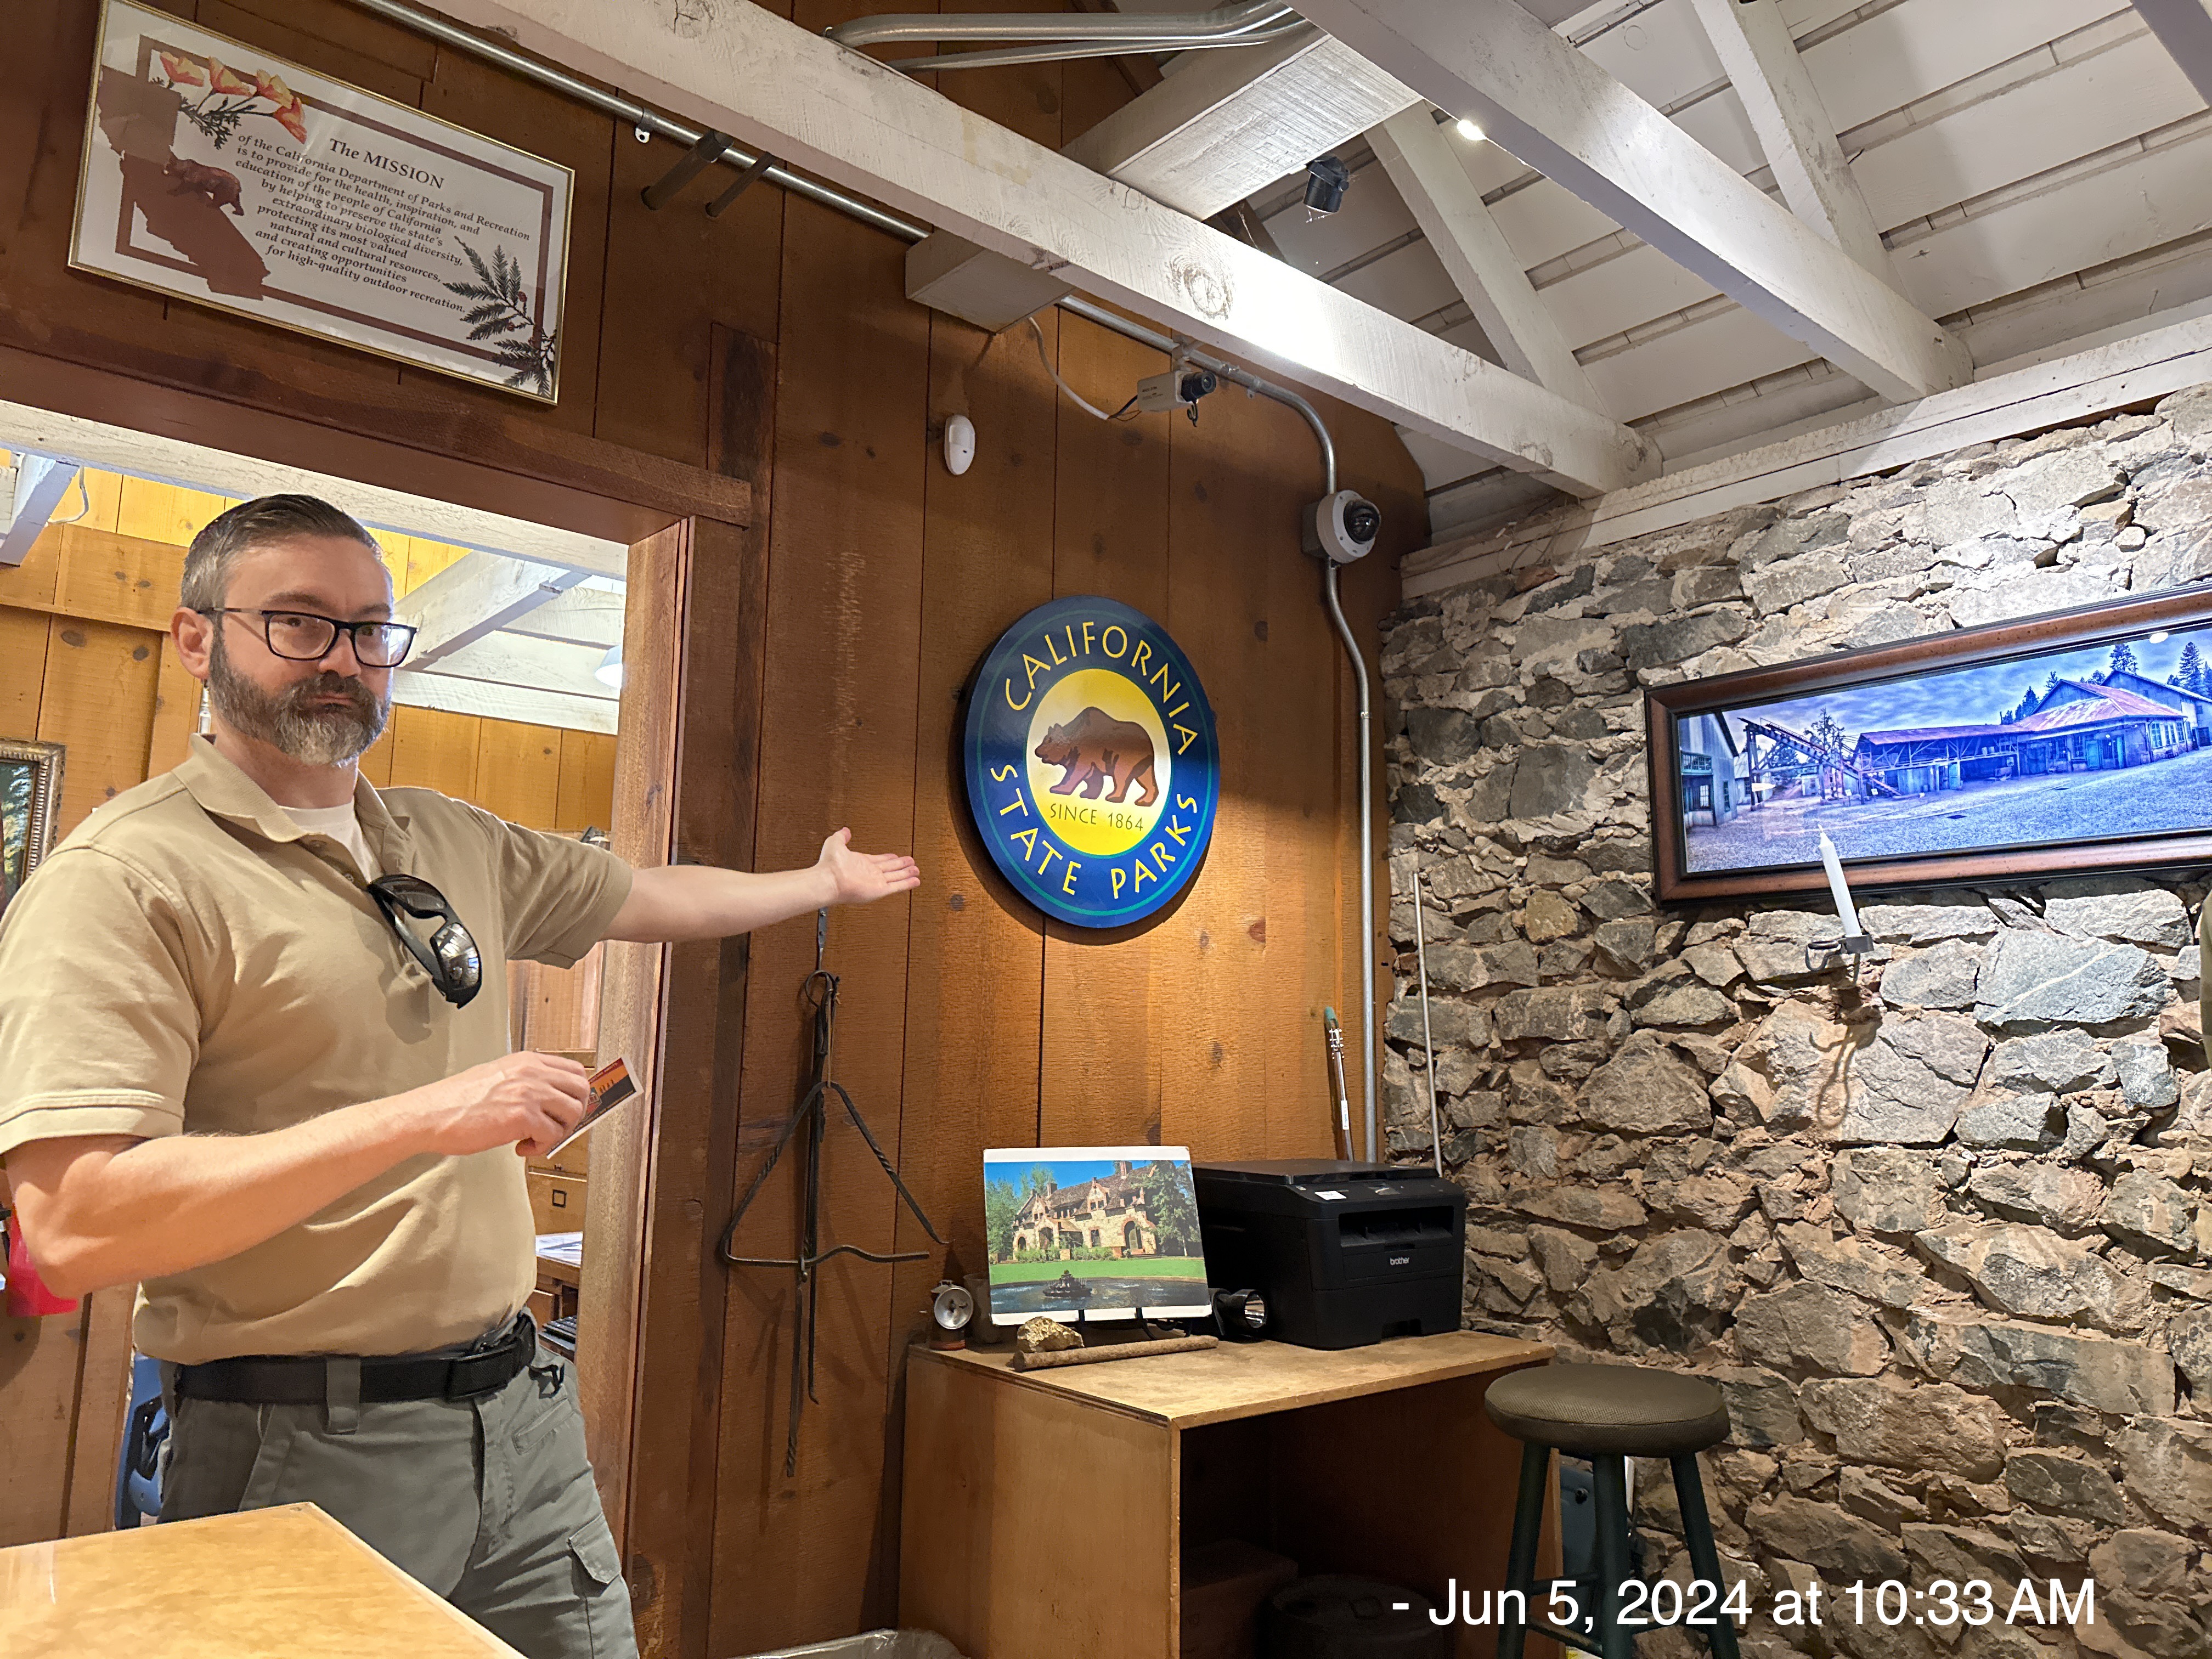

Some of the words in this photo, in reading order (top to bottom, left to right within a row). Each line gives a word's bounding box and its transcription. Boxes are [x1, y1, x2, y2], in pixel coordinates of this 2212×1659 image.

[235, 160, 294, 184] education
[298, 180, 311, 191] of
[313, 184, 331, 196] the
[332, 192, 370, 210] people
[373, 205, 386, 216] of
[387, 209, 442, 234] California
[237, 145, 247, 155] is
[251, 150, 263, 161] to
[266, 157, 312, 177] provide
[312, 172, 331, 183] for
[334, 179, 352, 191] the
[354, 185, 392, 206] health,
[396, 200, 457, 228] inspiration,
[460, 224, 480, 235] and
[238, 134, 252, 146] of
[254, 138, 273, 151] the
[276, 146, 335, 173] California
[338, 167, 405, 198] Department
[408, 194, 420, 204] of
[421, 196, 451, 213] Parks
[454, 210, 474, 221] and
[476, 215, 530, 240] Recreation
[330, 138, 359, 159] The
[363, 151, 444, 189] MISSION
[257, 205, 319, 232] protecting
[321, 223, 336, 235] its
[339, 231, 368, 246] most
[370, 240, 408, 258] valued
[262, 178, 276, 192] by
[279, 184, 323, 208] helping
[326, 201, 337, 211] to
[340, 207, 386, 227] preserve
[390, 222, 407, 234] the
[408, 229, 443, 246] state's
[273, 198, 353, 230] extraordinary
[356, 222, 411, 248] biological
[413, 242, 463, 266] diversity,
[255, 230, 278, 242] and
[281, 238, 329, 260] creating
[331, 254, 407, 283] opportunities
[266, 245, 286, 257] for
[288, 250, 360, 282] high-quality
[363, 276, 408, 295] outdoor
[410, 291, 466, 313] recreation.
[270, 222, 314, 241] natural
[317, 238, 340, 249] and
[341, 245, 387, 264] cultural
[390, 259, 441, 283] resources,
[1006, 621, 1198, 755] CALIFORNIA
[991, 764, 1081, 895] STATE
[1111, 793, 1198, 899] PARKS
[1050, 803, 1097, 826] SINCE
[1107, 812, 1144, 832] 1864
[1390, 1257, 1410, 1265] brother
